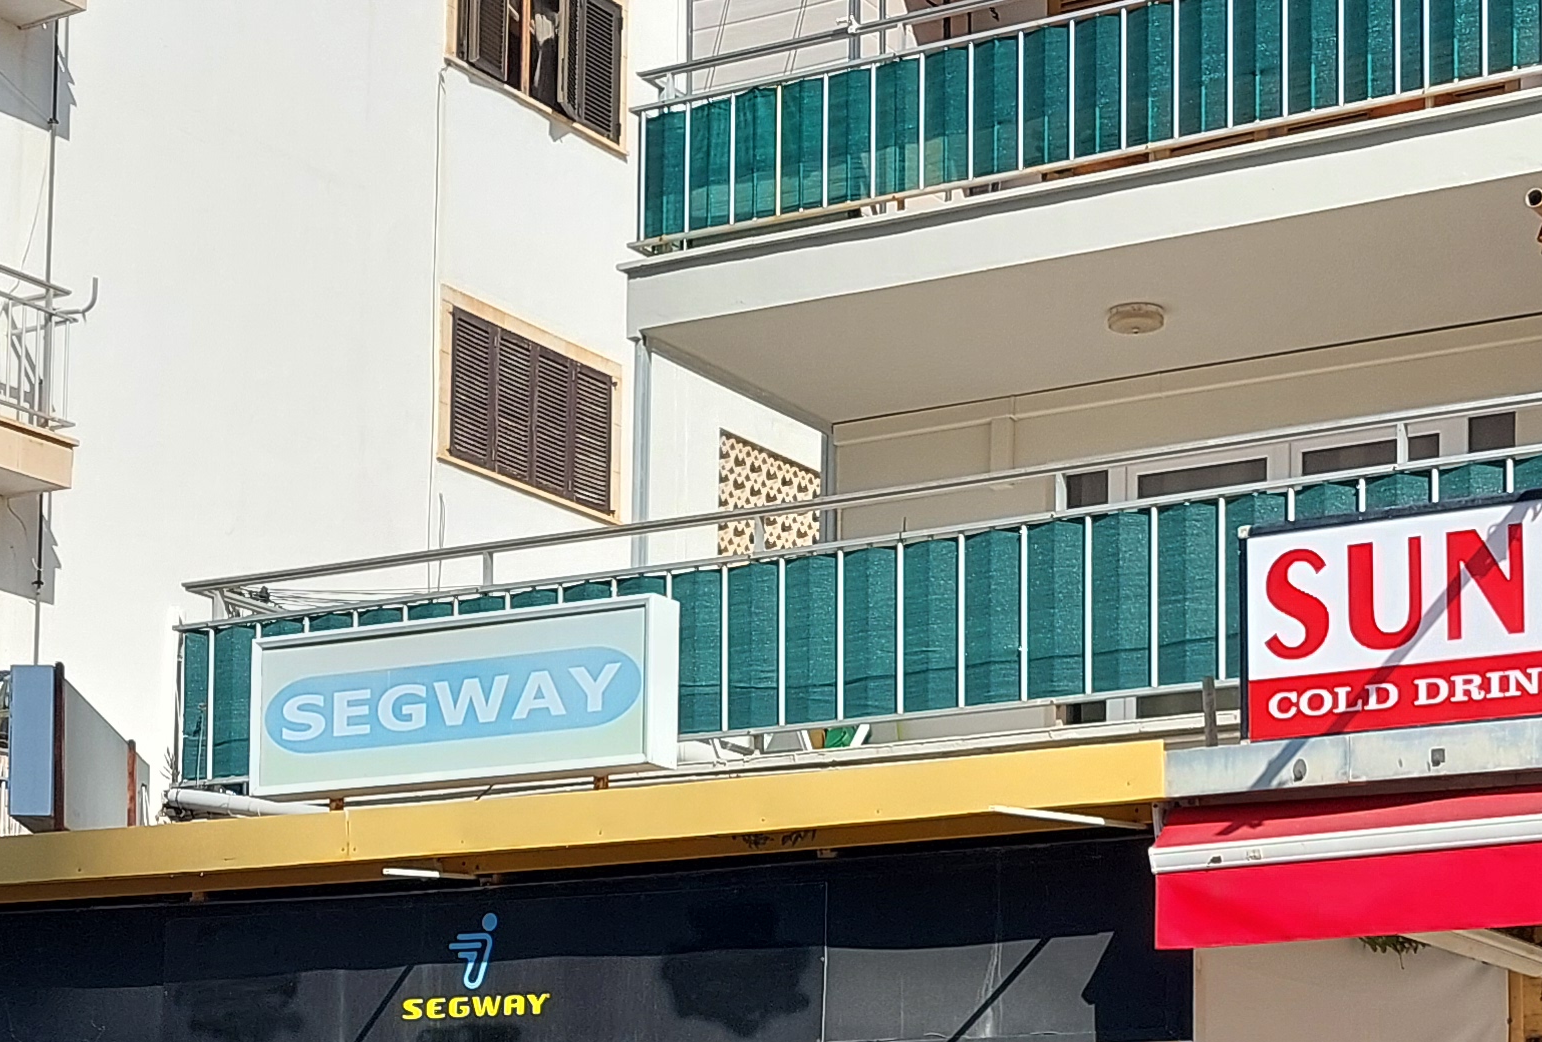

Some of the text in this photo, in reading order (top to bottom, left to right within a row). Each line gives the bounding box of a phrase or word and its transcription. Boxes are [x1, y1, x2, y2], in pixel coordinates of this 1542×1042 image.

[280, 662, 625, 743] SEGWAY
[1267, 683, 1401, 720] COLD
[401, 992, 548, 1020] SEGWAY
